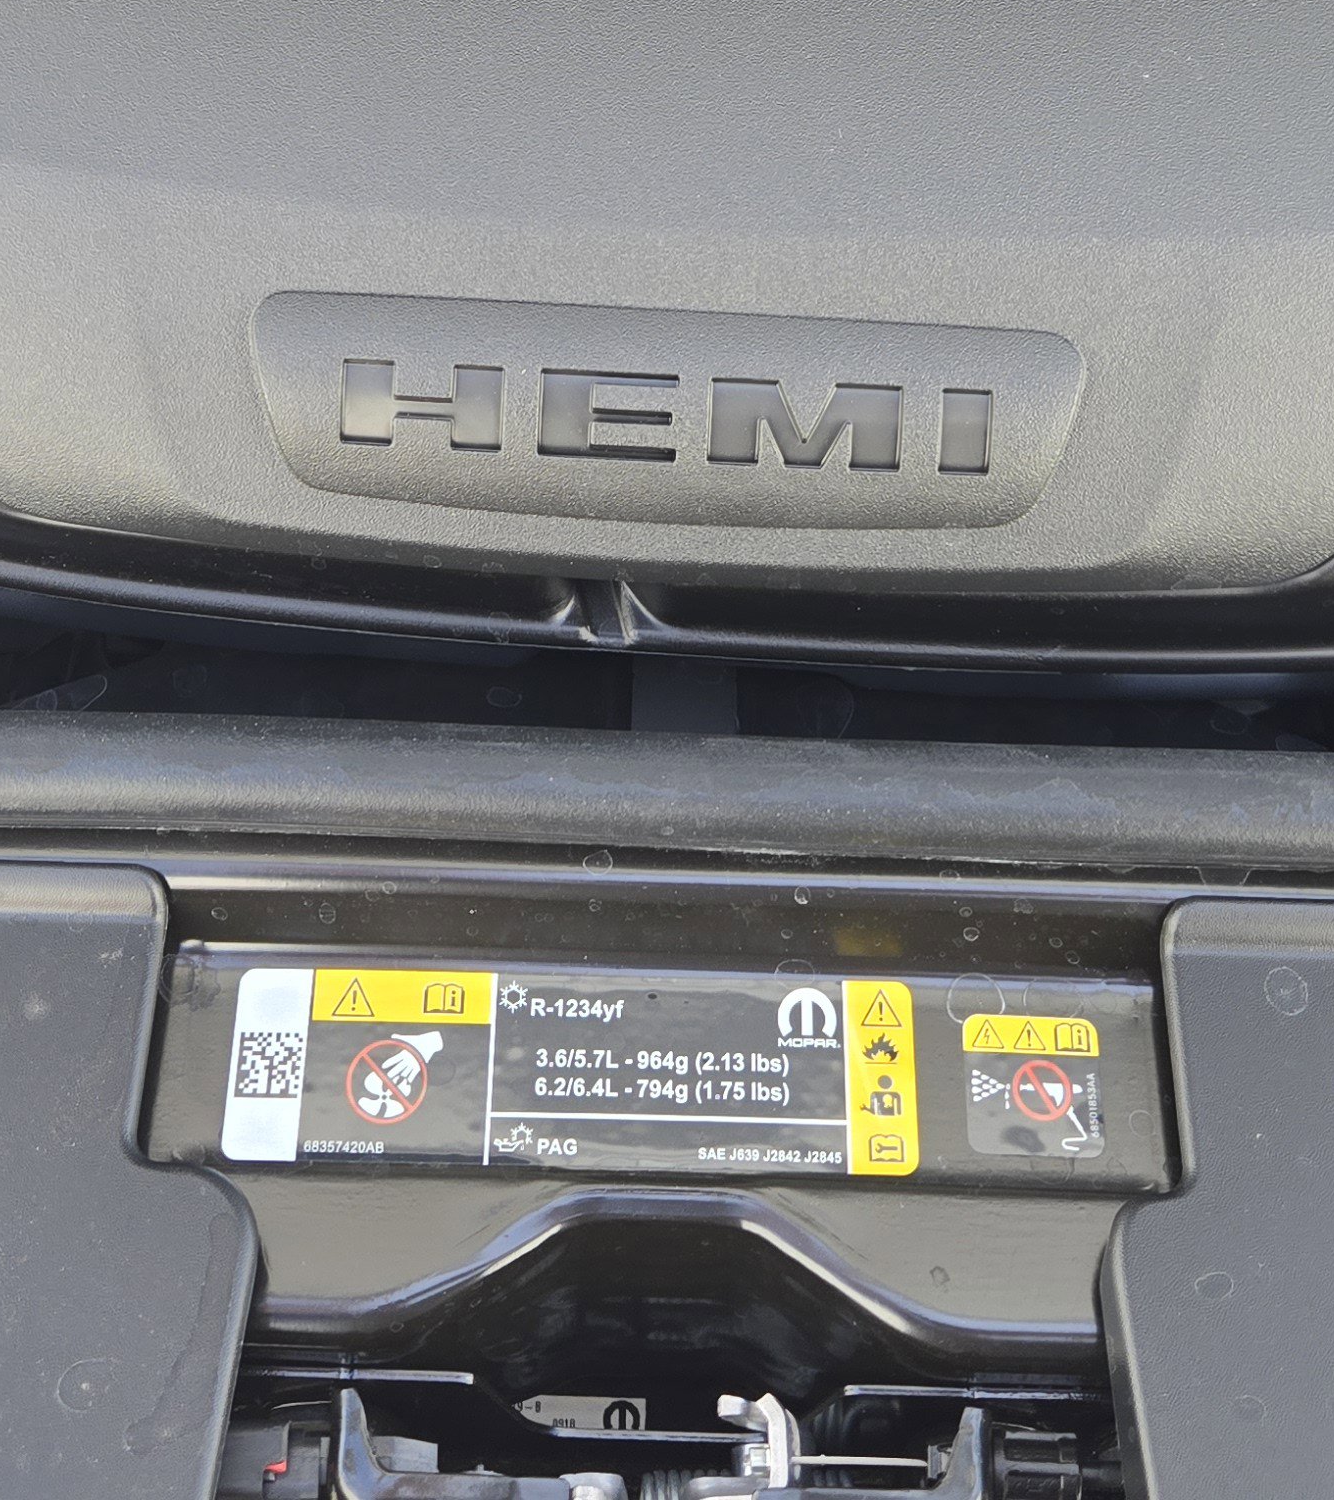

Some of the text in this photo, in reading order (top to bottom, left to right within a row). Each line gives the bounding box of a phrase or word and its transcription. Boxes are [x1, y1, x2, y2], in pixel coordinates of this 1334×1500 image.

[339, 356, 994, 476] HEMI
[529, 998, 624, 1023] R-1234yf
[535, 1049, 619, 1069] 3.6/5.7L
[637, 1051, 689, 1075] 964g
[695, 1052, 745, 1076] (2.13
[750, 1052, 789, 1077] lbs)
[534, 1078, 619, 1098] 6.2/6.4L
[636, 1080, 689, 1103] 794g
[695, 1081, 745, 1105] (1.75
[750, 1081, 790, 1106] lbs)
[303, 1140, 385, 1154] 68357420AB
[537, 1138, 578, 1156] PAG
[697, 1147, 842, 1165] SAE J639 J2842 J2845
